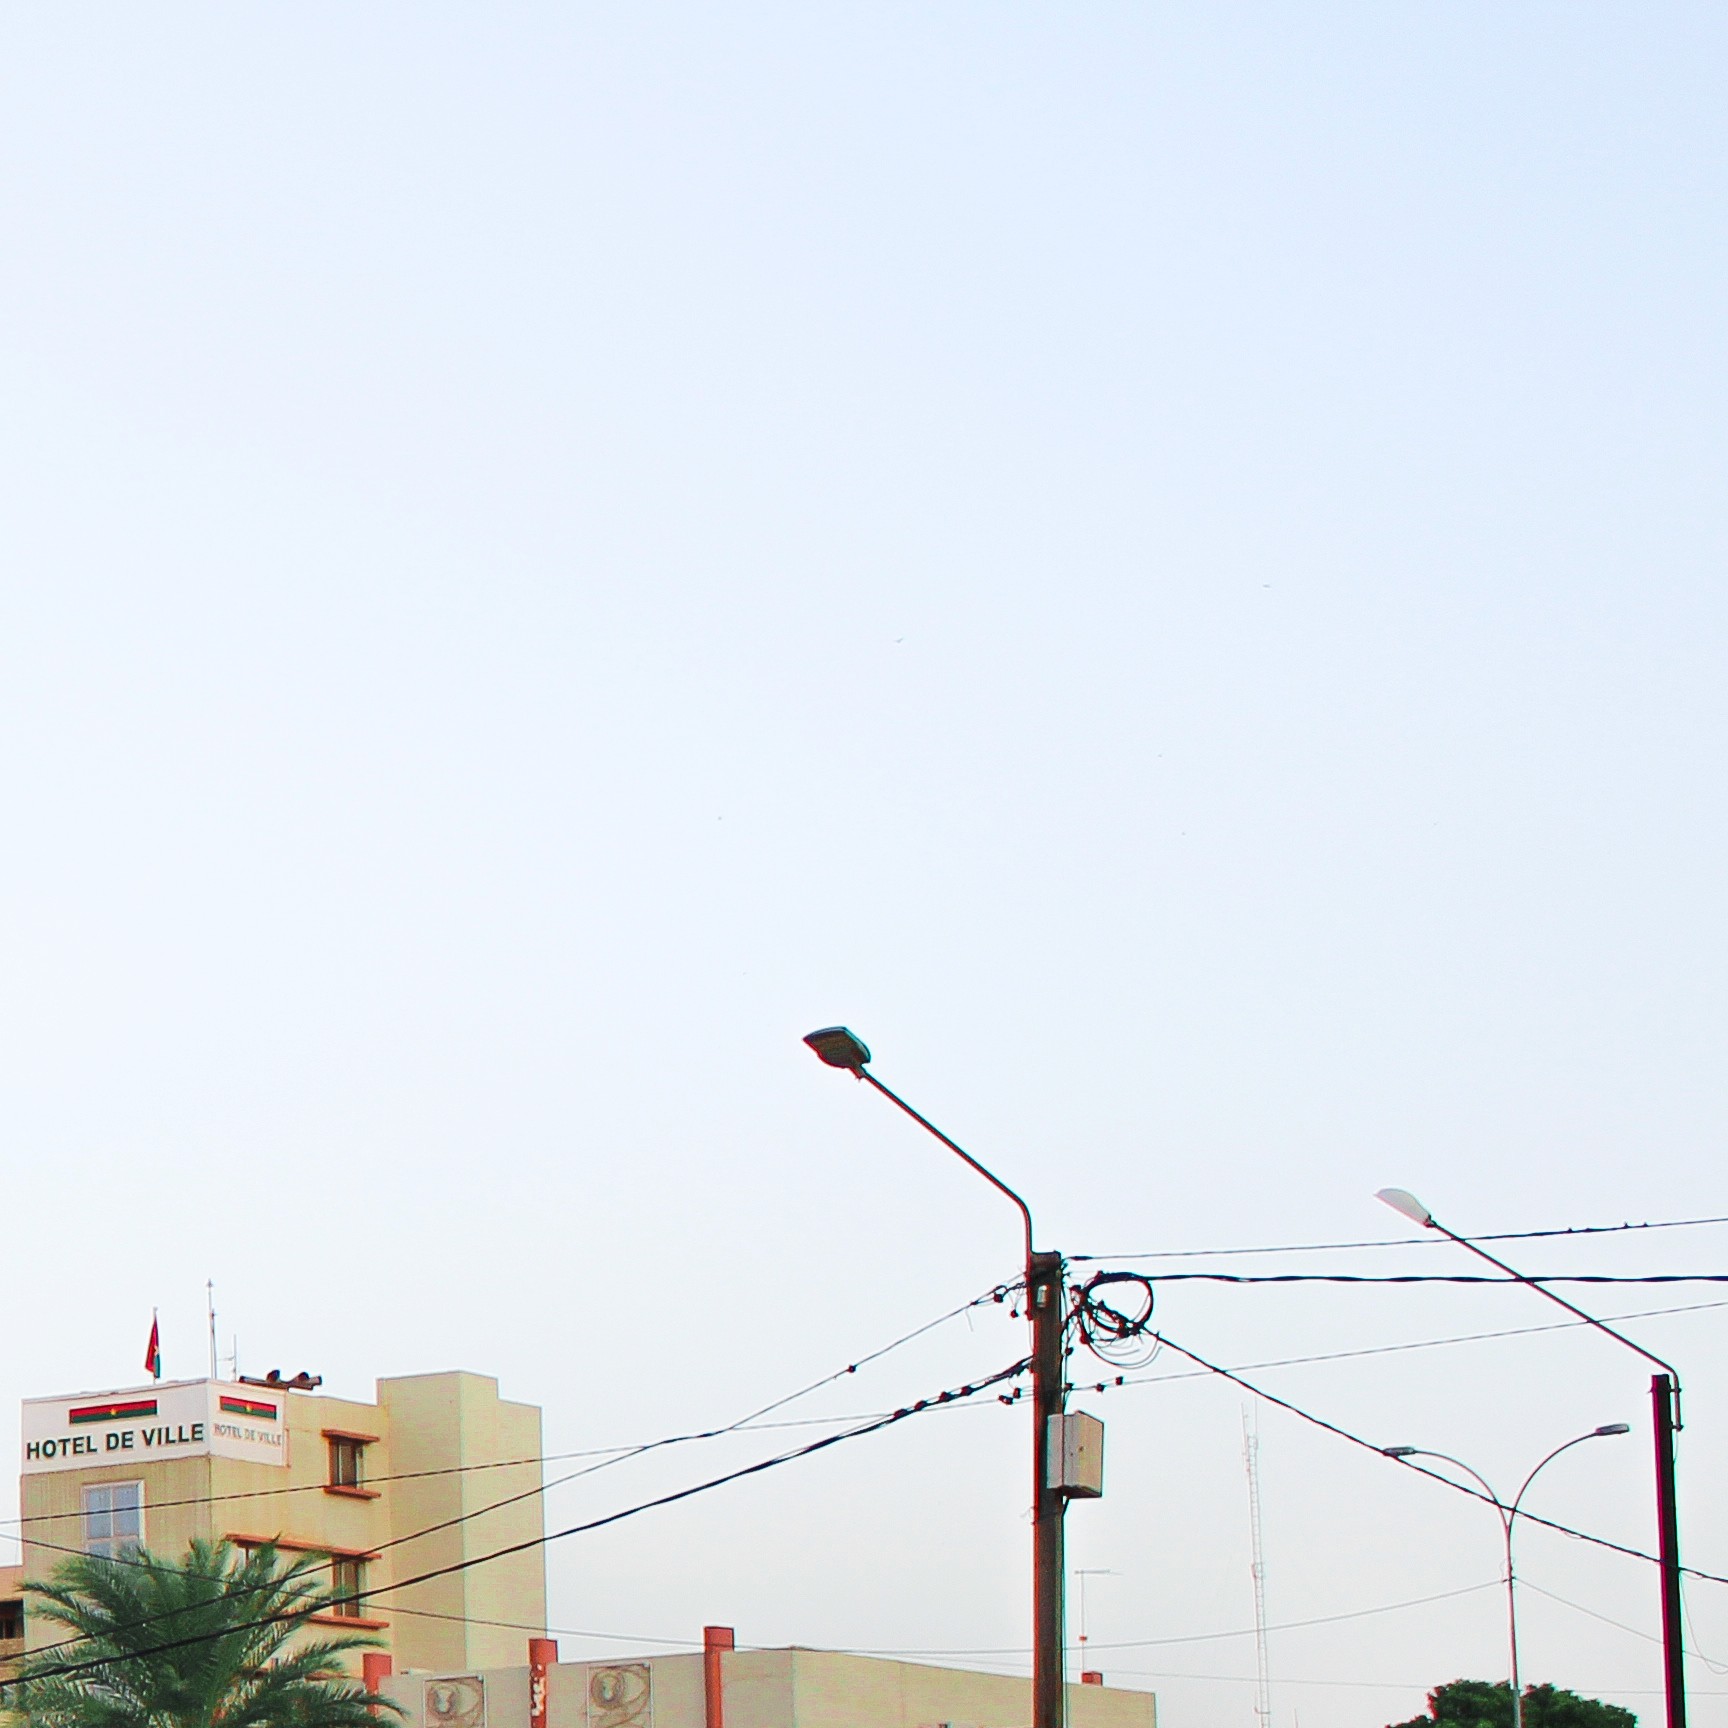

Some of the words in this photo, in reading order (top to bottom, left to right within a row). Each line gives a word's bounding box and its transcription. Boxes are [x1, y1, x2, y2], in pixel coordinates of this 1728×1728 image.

[26, 1435, 97, 1460] HOTEL
[106, 1430, 134, 1451] DE
[142, 1423, 204, 1447] VILLE
